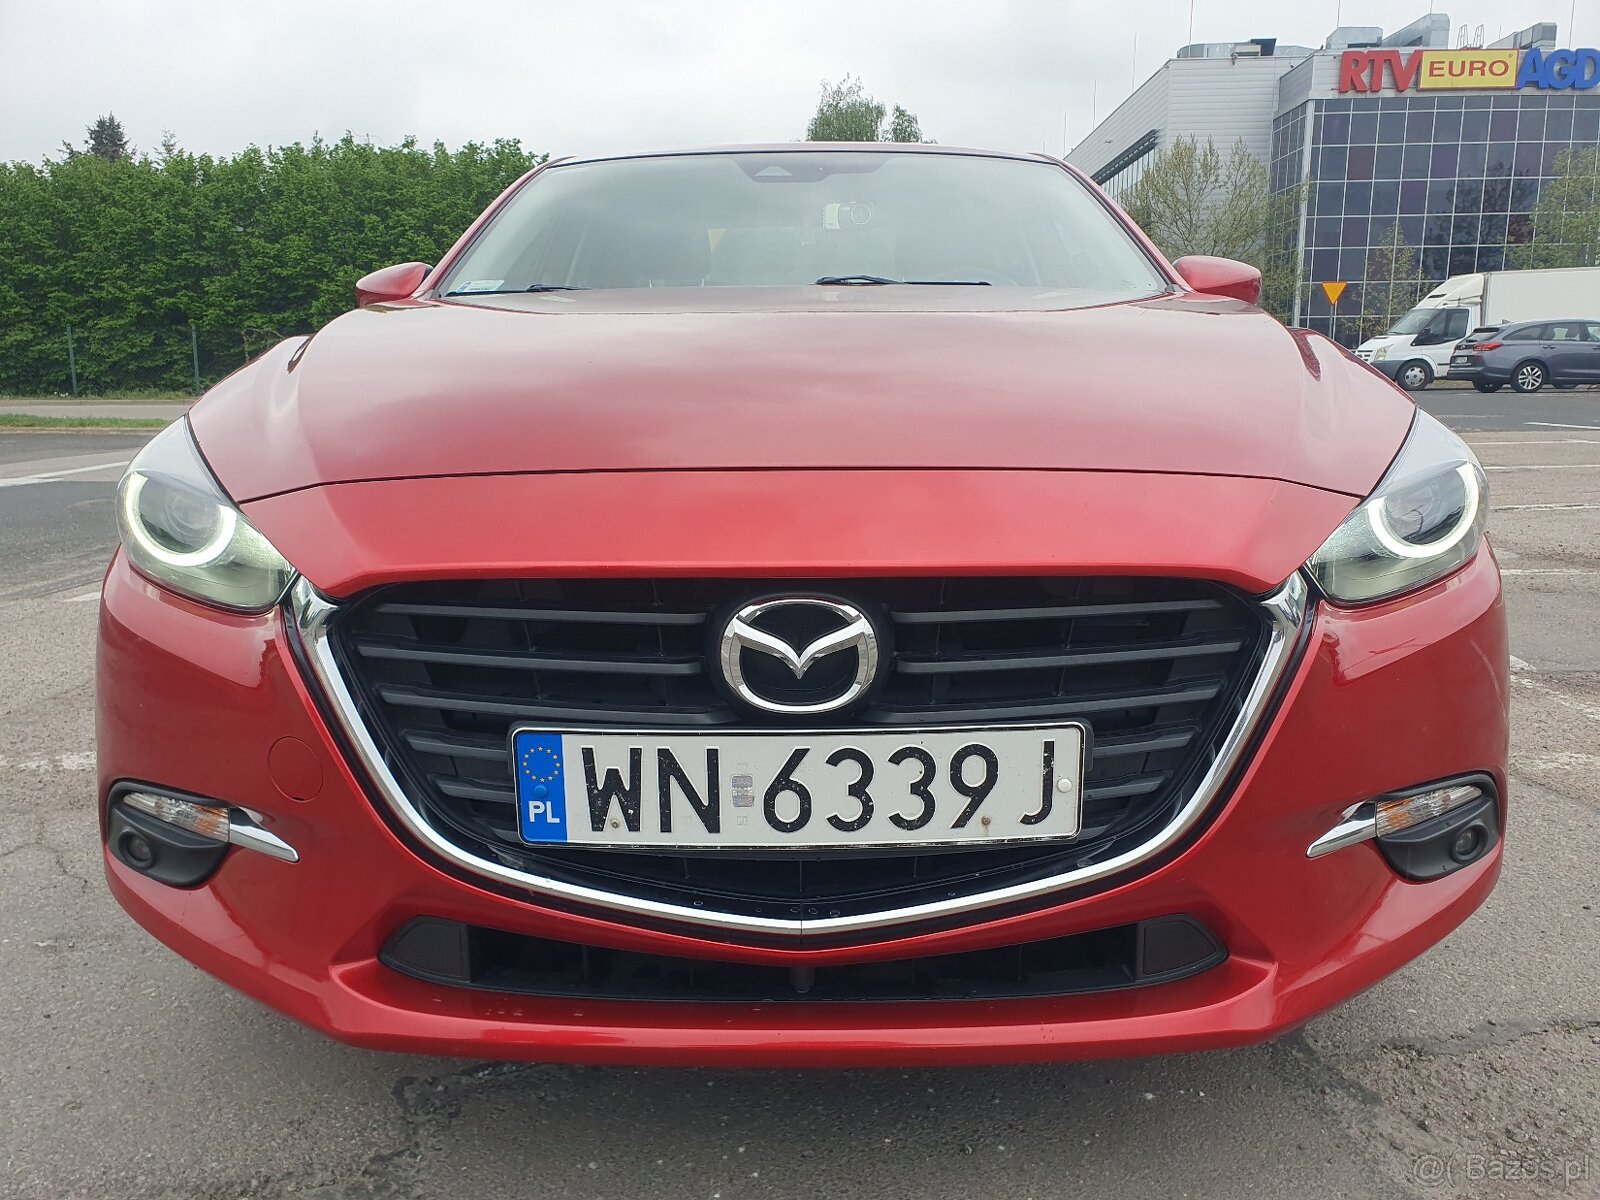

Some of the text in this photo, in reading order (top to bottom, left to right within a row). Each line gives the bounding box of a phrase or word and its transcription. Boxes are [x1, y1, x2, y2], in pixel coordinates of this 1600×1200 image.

[1339, 48, 1600, 93] RTV EURO AGD
[528, 800, 560, 824] PL
[581, 746, 721, 833] WN
